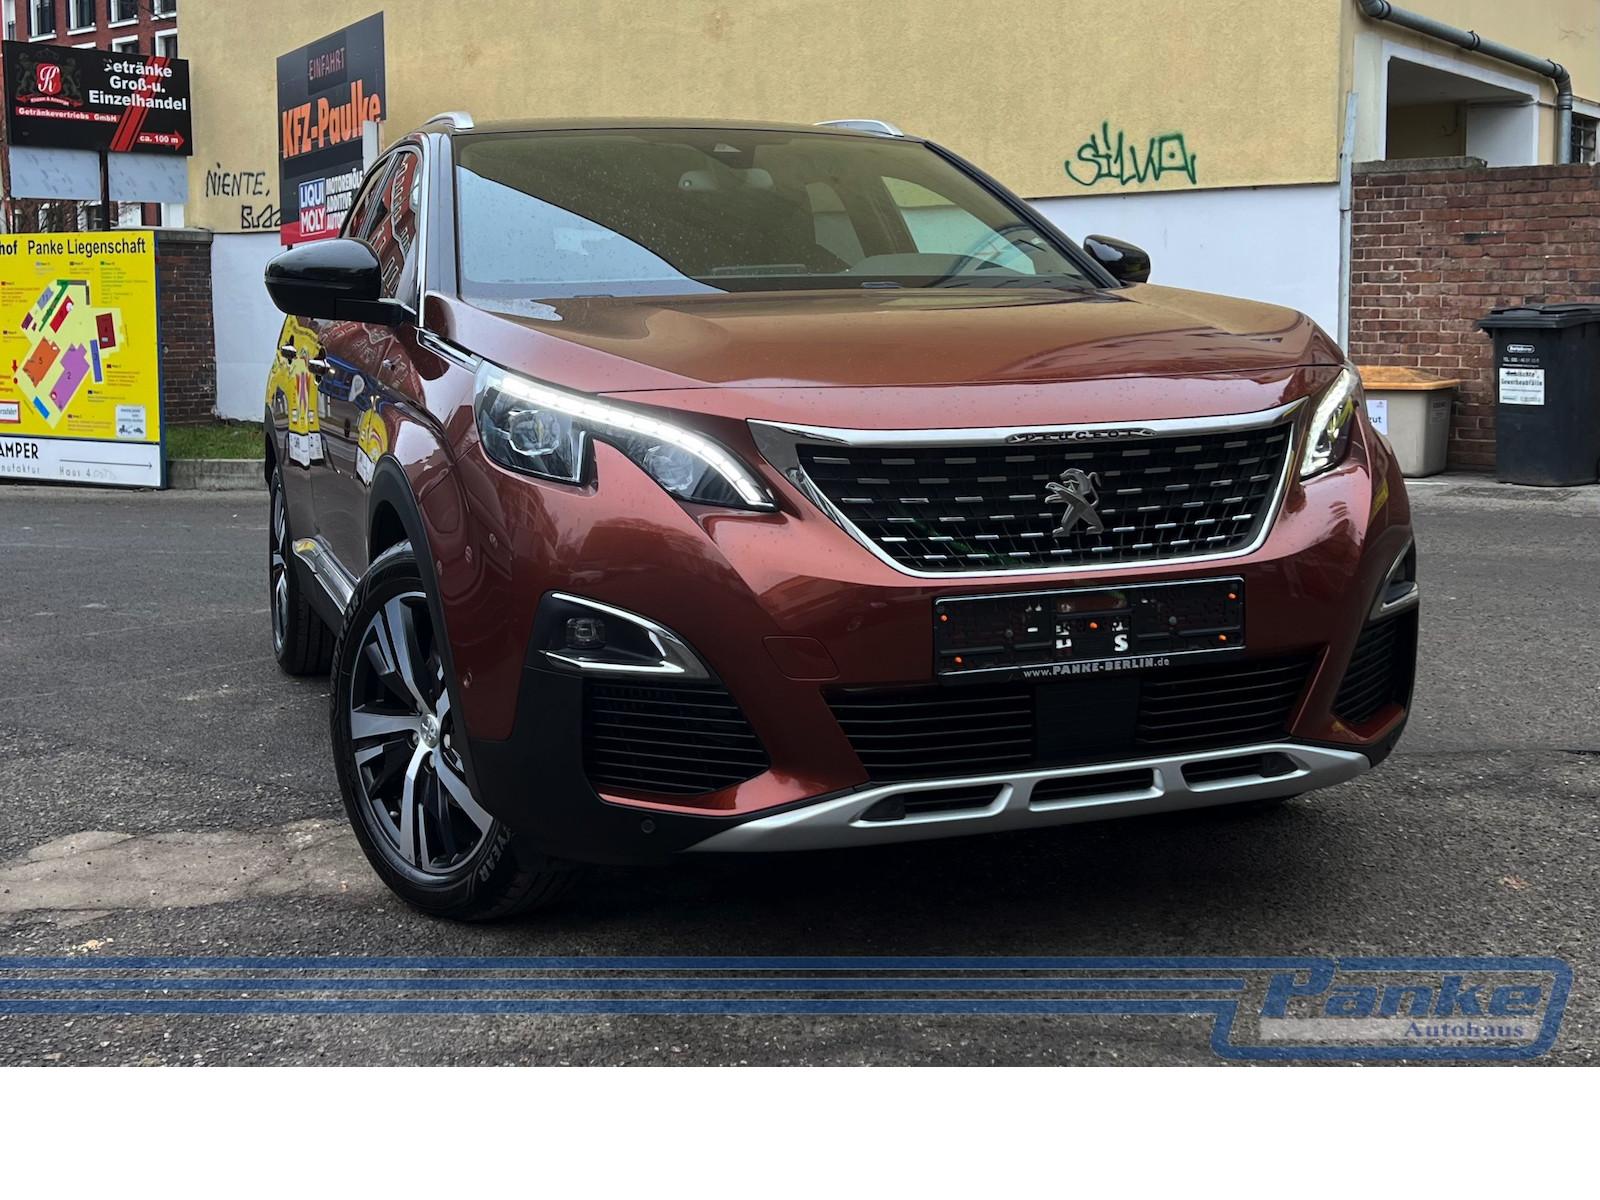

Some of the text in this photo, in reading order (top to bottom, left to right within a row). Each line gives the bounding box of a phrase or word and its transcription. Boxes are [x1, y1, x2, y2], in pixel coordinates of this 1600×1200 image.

[308, 48, 345, 80] EINFAHRT
[110, 76, 166, 93] Groß-u.
[88, 90, 187, 110] Einzelhandel
[18, 107, 117, 122] Getränkevertriebs GmbH
[282, 79, 381, 159] KFZ-Paulke
[139, 134, 153, 142] ca.
[154, 135, 169, 143] 100
[300, 182, 325, 208] LIQUI
[326, 191, 352, 213] ADDITIVE
[300, 207, 326, 233] MOLY
[28, 240, 64, 255] Panke
[67, 237, 146, 258] Liegenschaft
[1026, 428, 1140, 442] PEUGEOT
[1023, 657, 1170, 678] www.PANKE-BERLIN.de
